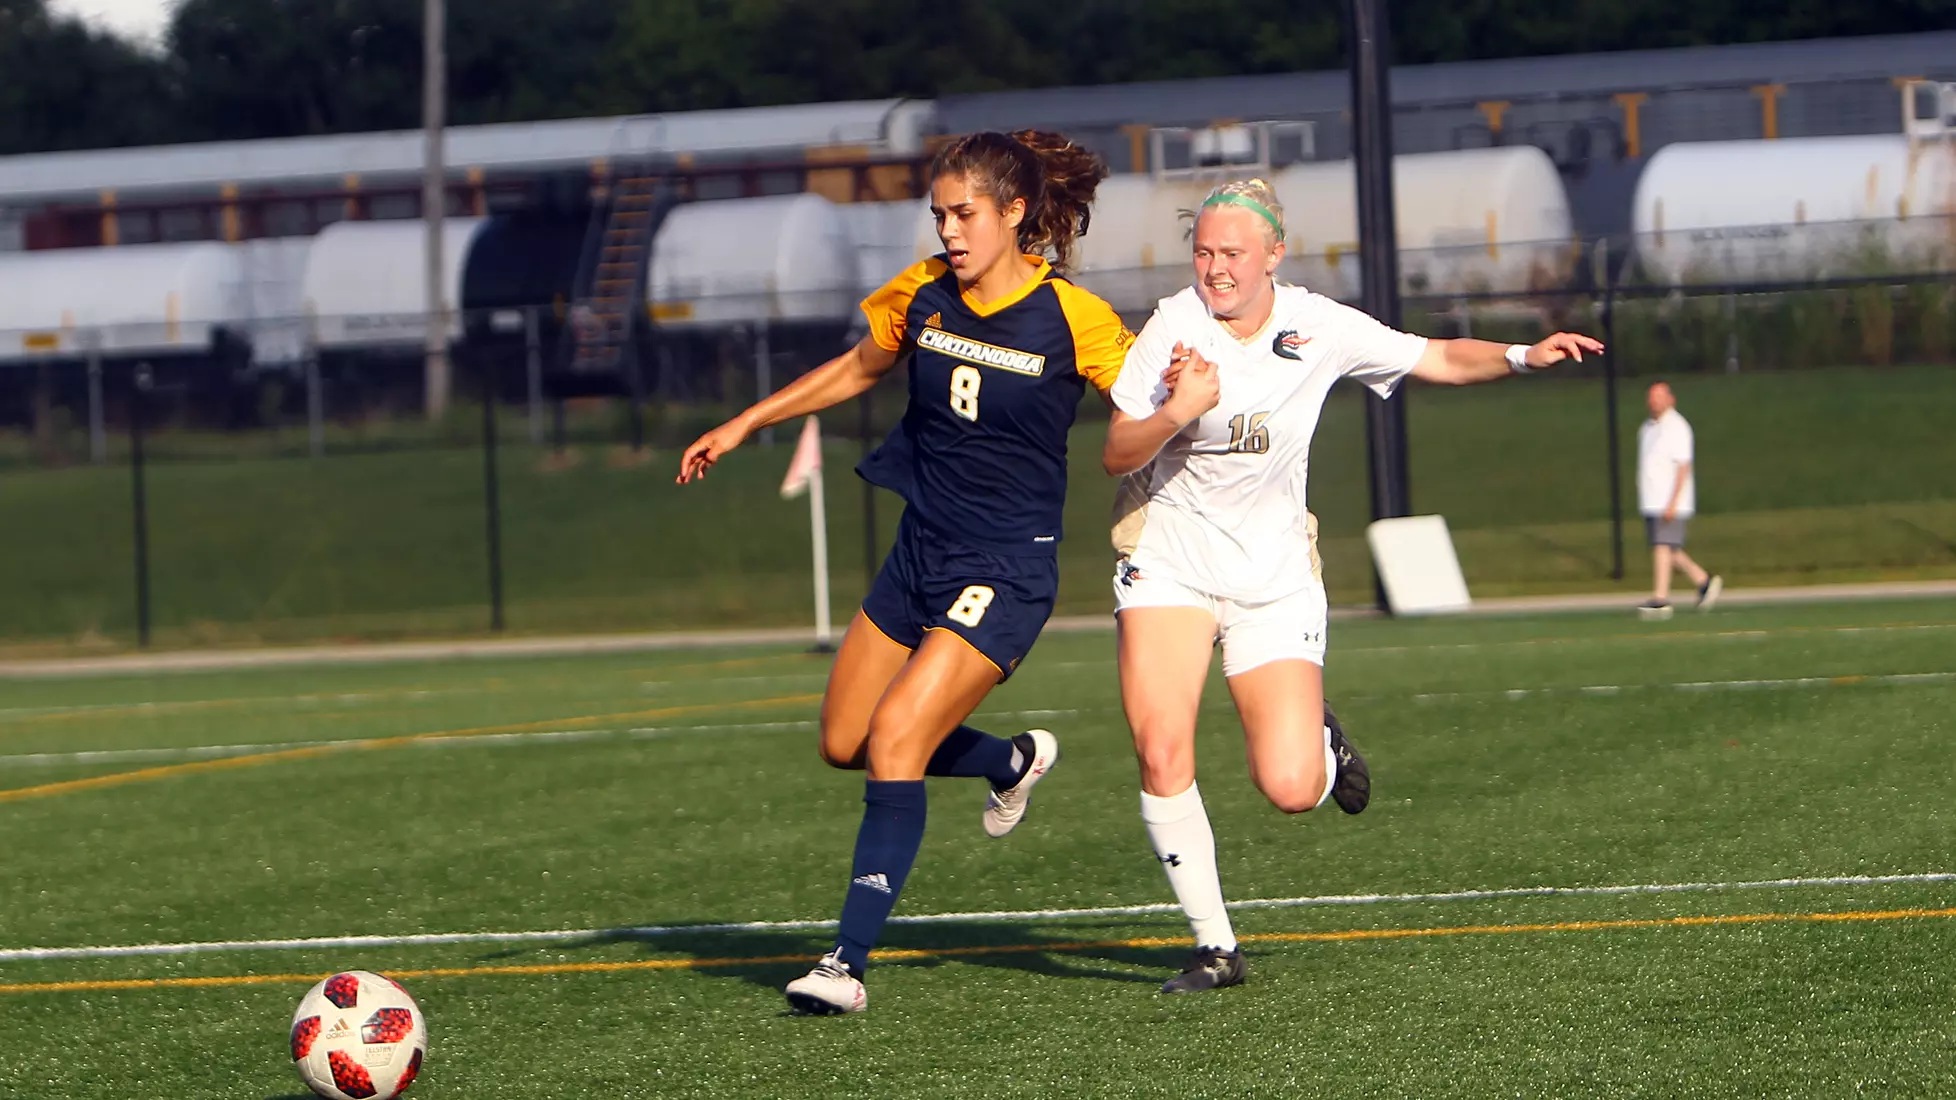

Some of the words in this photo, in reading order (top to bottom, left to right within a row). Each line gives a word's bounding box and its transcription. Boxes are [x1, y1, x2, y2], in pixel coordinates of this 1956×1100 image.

[919, 330, 1044, 374] CHATTANOOGA
[950, 364, 982, 422] 8
[1228, 411, 1270, 454] 16
[946, 585, 996, 628] 8
